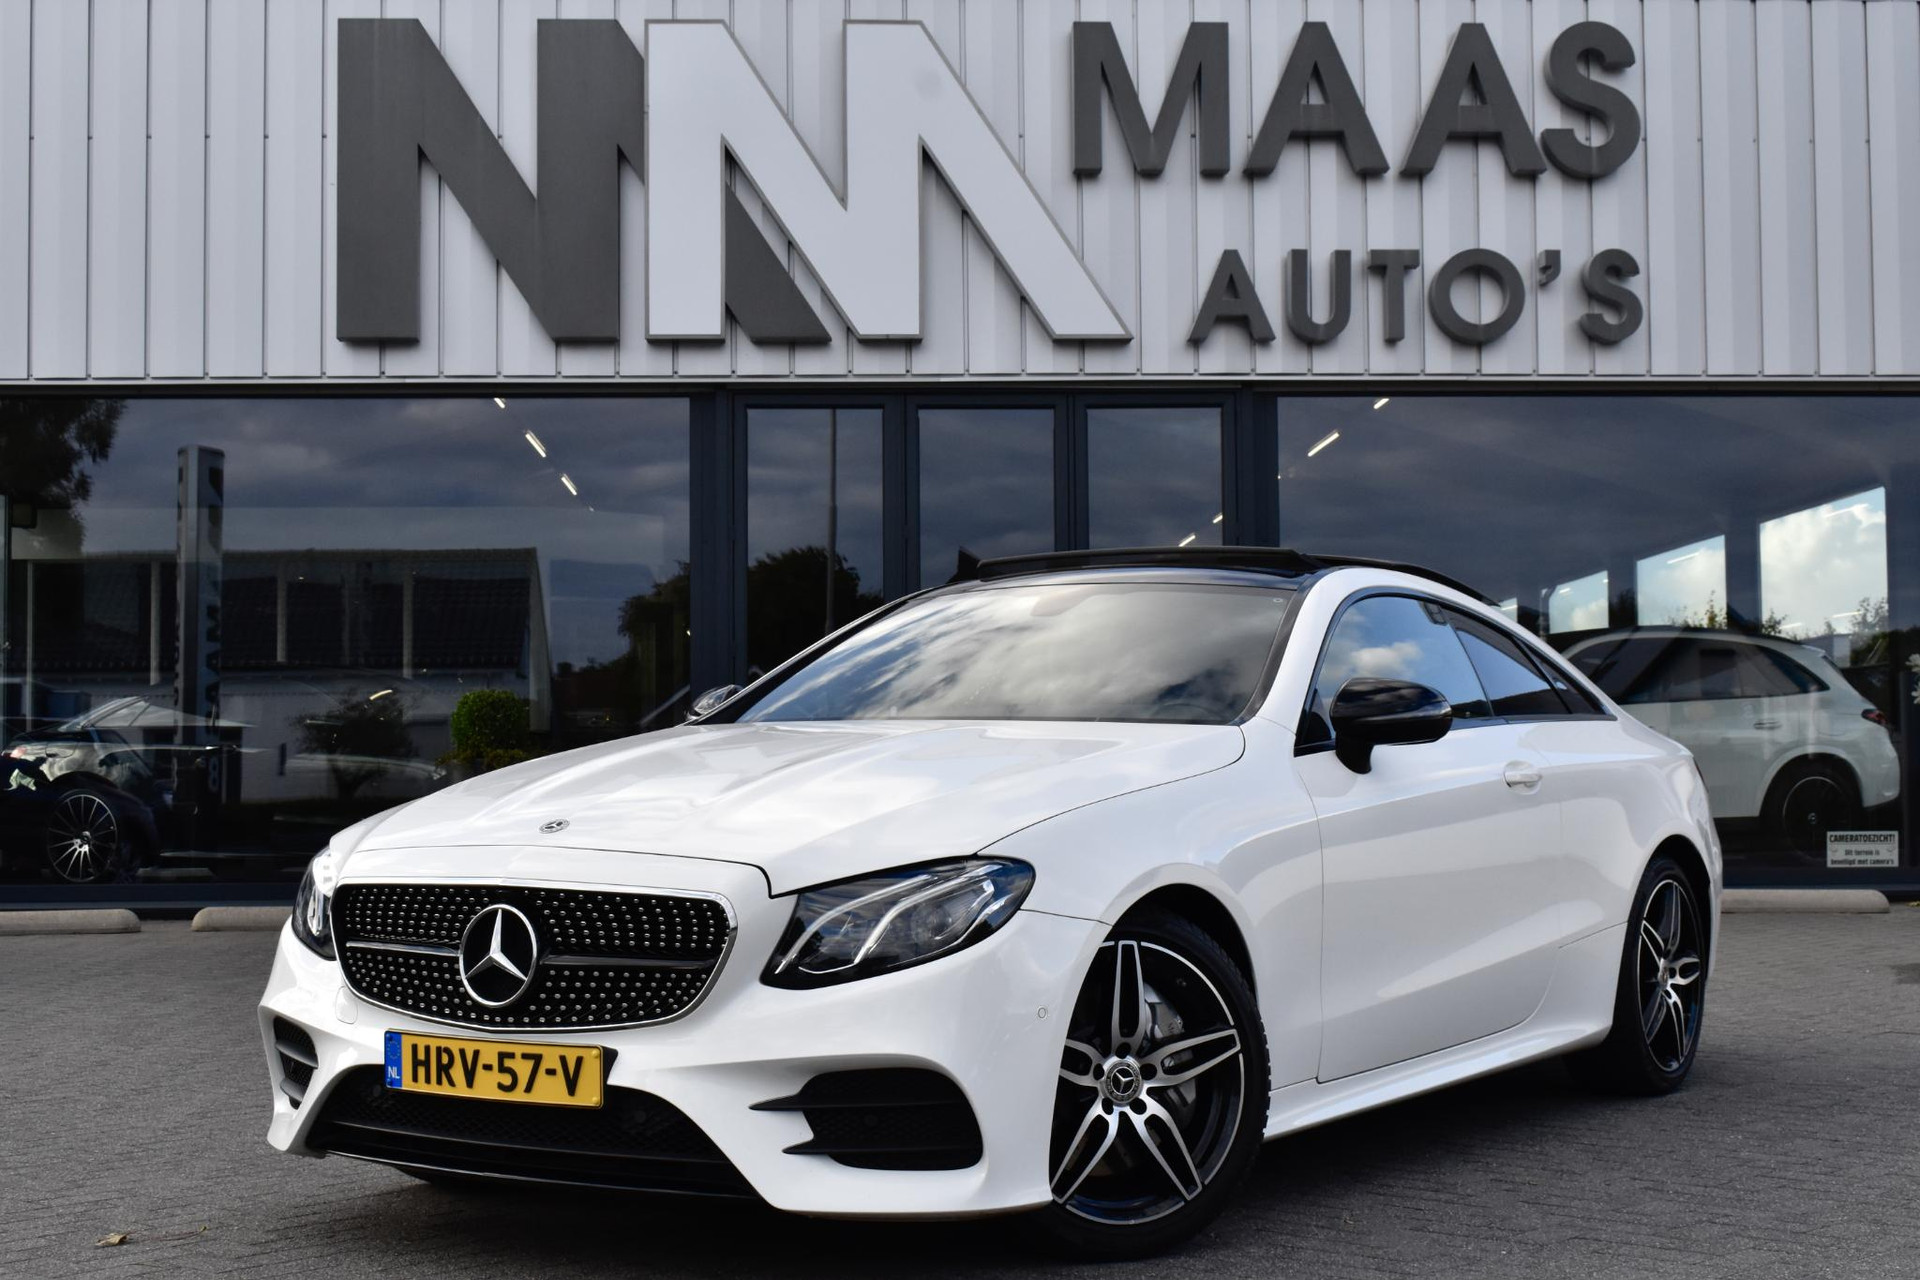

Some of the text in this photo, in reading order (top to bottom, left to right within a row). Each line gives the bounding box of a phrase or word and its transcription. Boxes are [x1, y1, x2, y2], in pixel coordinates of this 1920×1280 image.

[1073, 20, 1642, 180] MAAS
[1186, 247, 1644, 347] AUTO'S
[387, 1065, 400, 1080] NL
[411, 1043, 584, 1097] HRV-57-V
